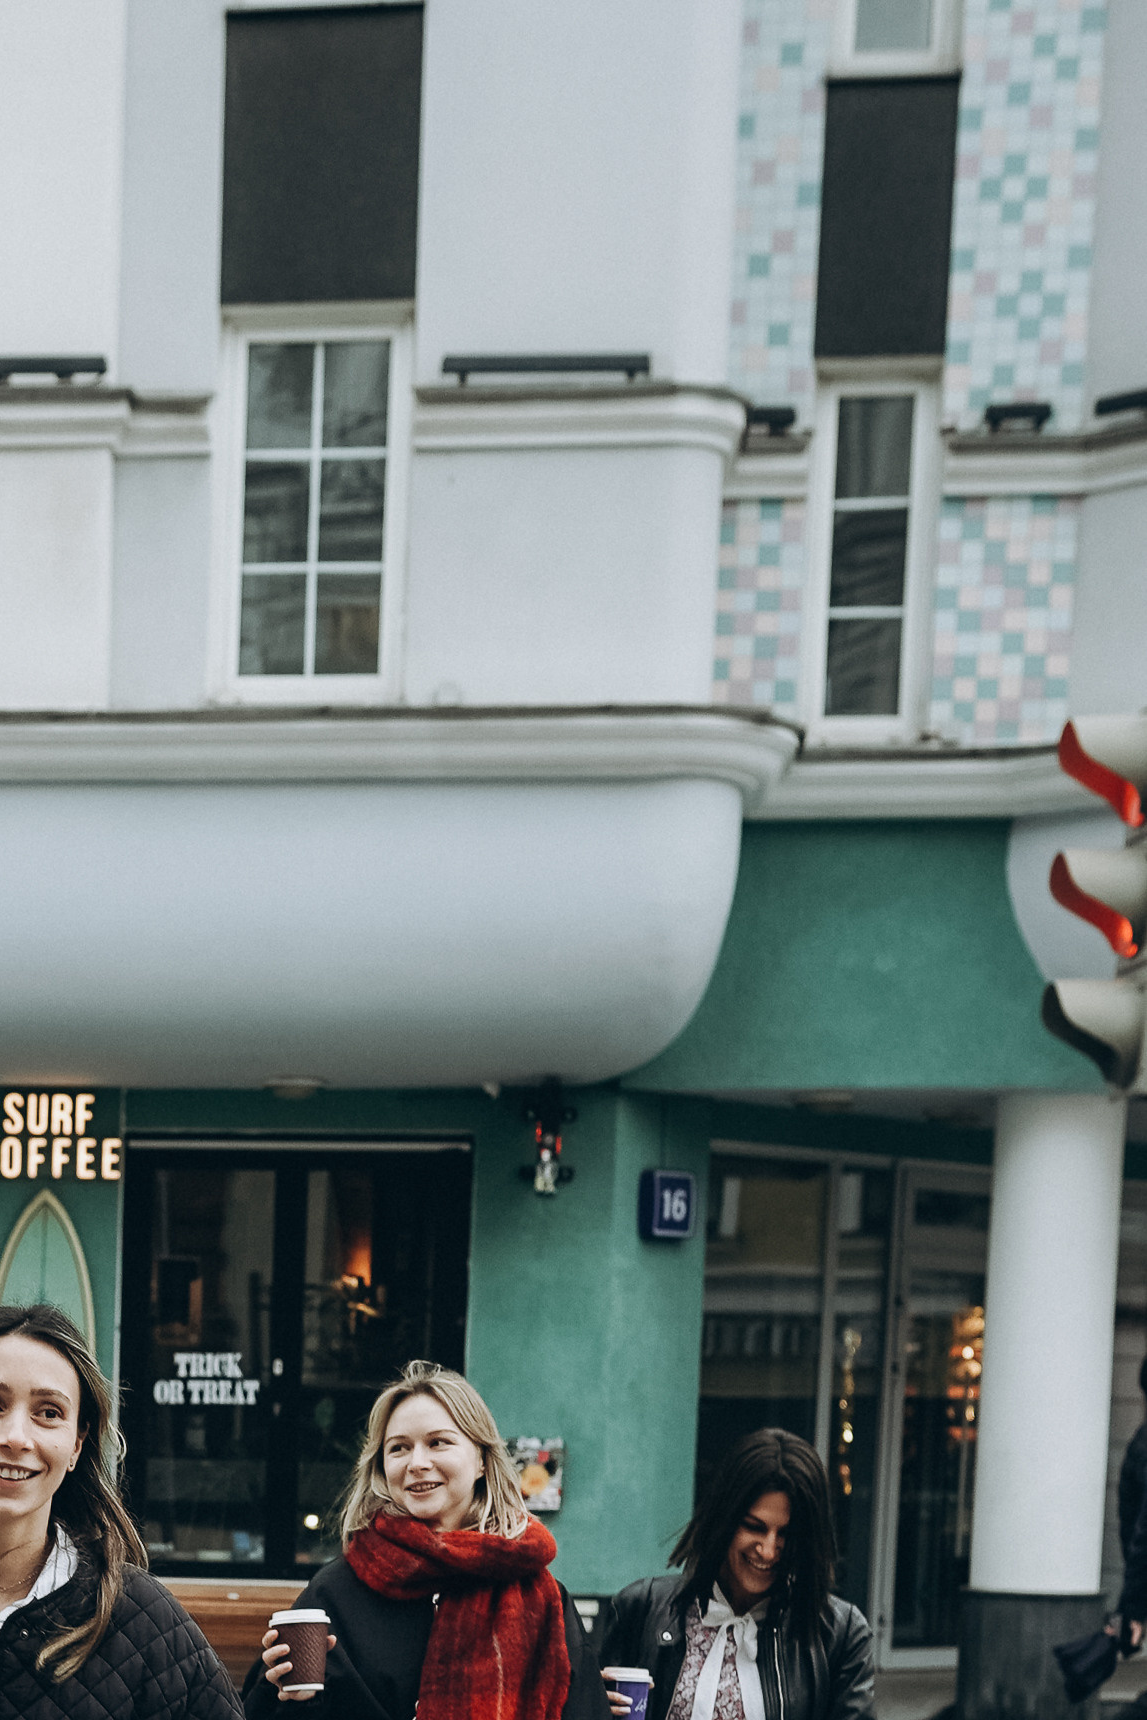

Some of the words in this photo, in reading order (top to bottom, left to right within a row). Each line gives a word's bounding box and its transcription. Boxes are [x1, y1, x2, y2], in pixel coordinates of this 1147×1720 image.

[2, 1091, 96, 1136] SURF
[662, 1187, 688, 1222] 16
[172, 1351, 244, 1379] TRICK
[153, 1379, 186, 1406] OR
[186, 1379, 261, 1406] TREAT
